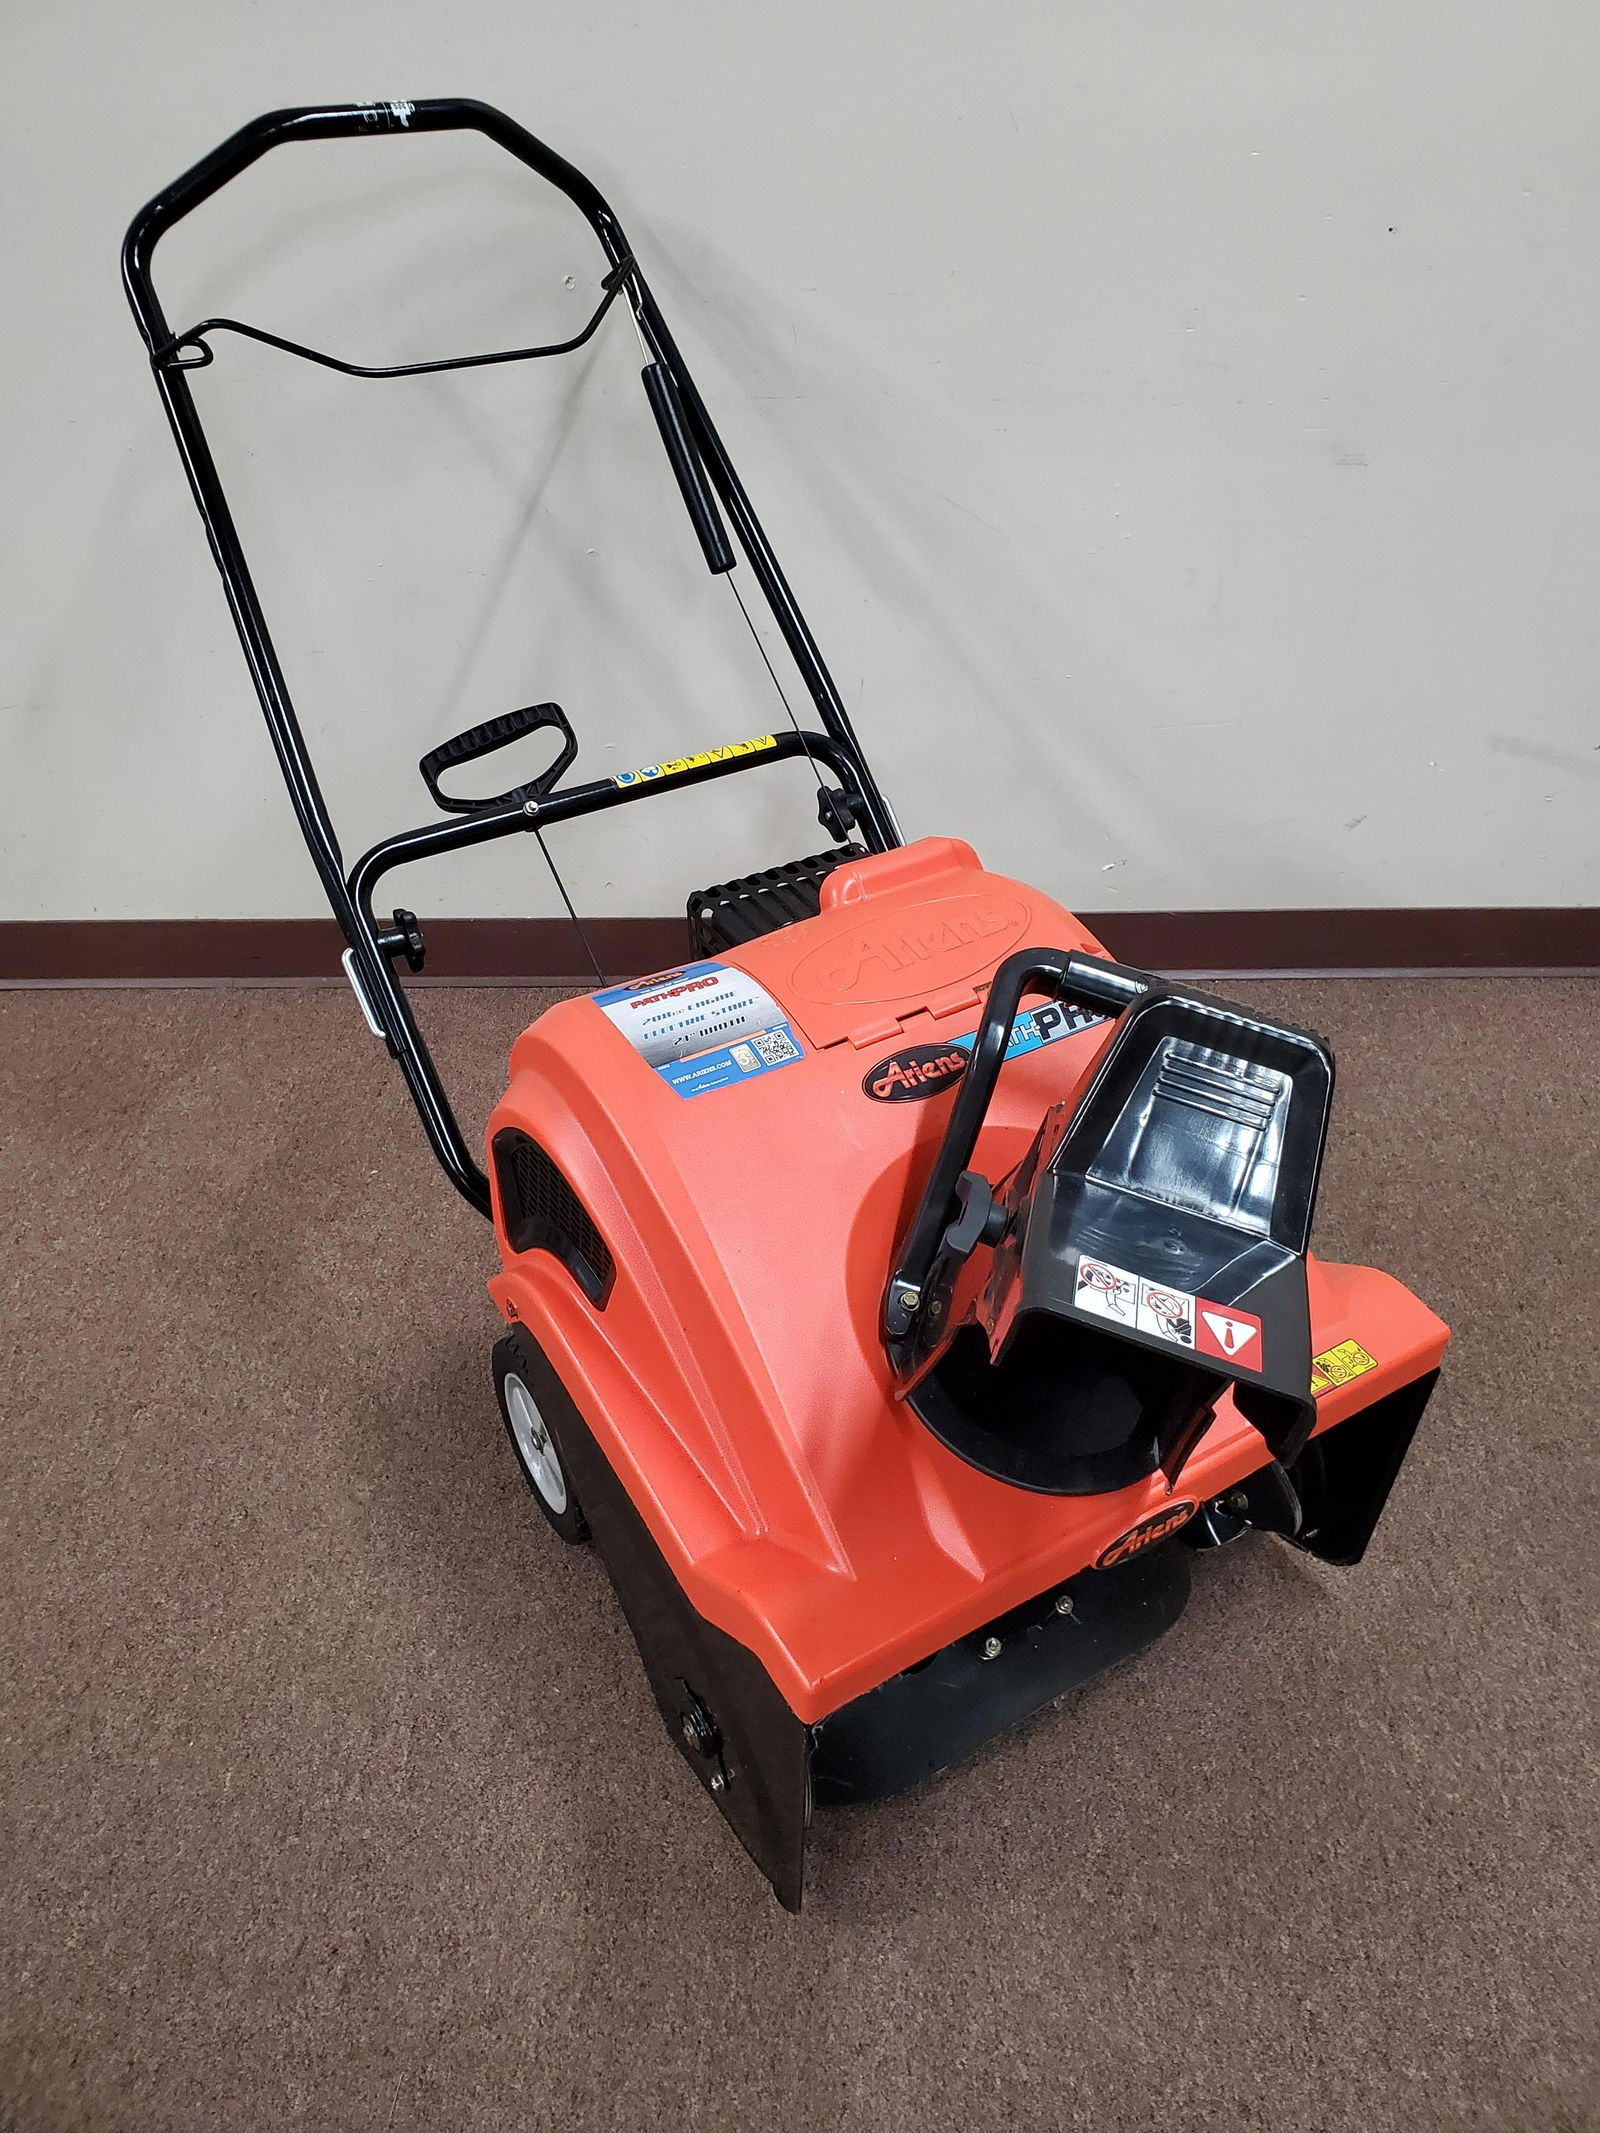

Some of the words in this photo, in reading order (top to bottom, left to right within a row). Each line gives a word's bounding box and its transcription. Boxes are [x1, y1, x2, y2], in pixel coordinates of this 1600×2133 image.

[630, 976, 719, 1010] PATHPRO
[672, 1059, 733, 1085] WWW.ARIENS.COM
[872, 1051, 968, 1098] Ariens
[1102, 1509, 1189, 1567] Ariens
